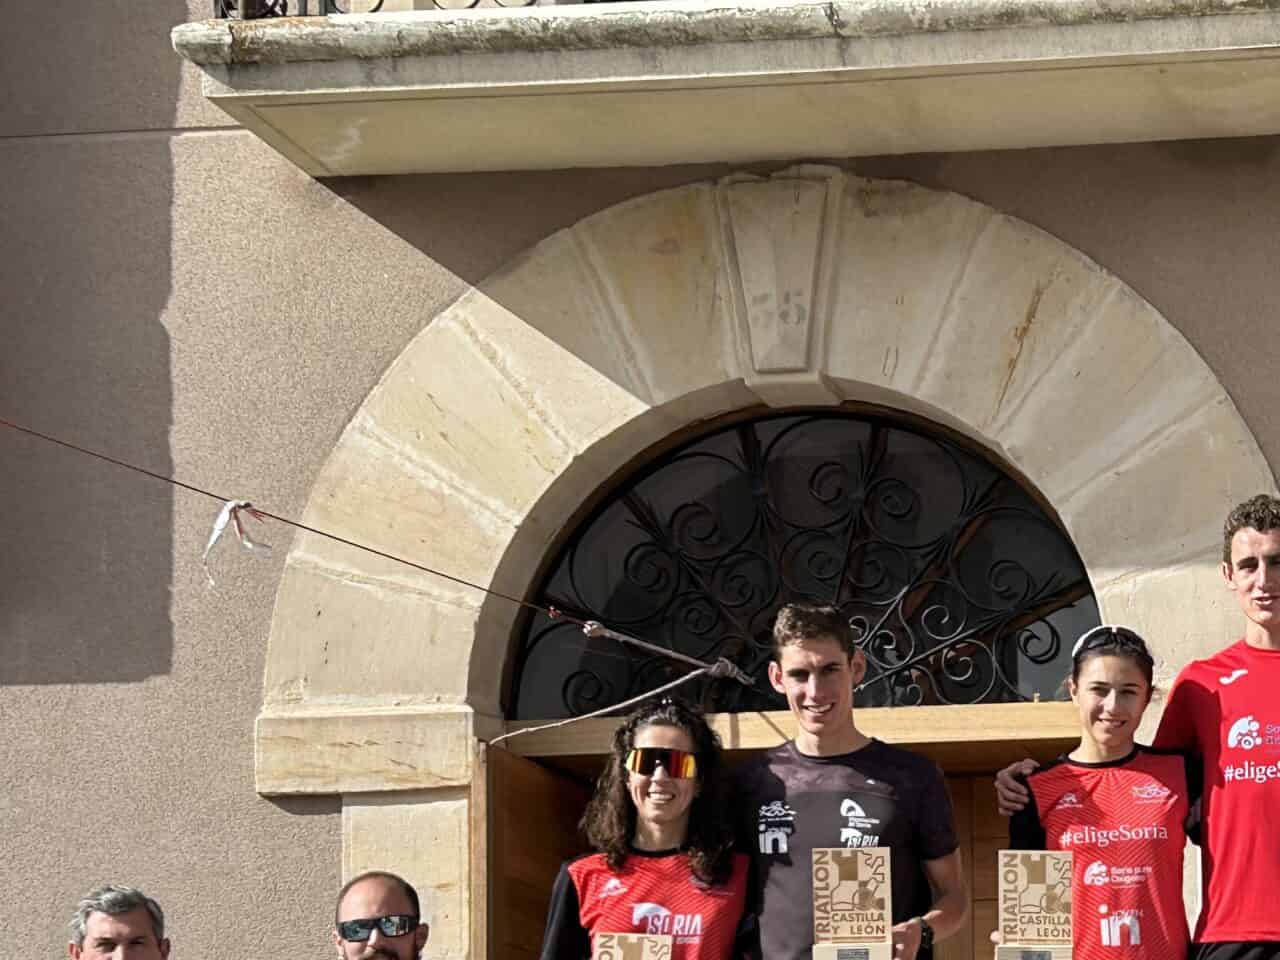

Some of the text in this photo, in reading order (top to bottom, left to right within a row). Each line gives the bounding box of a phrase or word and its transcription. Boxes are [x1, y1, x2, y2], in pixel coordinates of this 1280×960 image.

[1060, 824, 1168, 848] #eligeSoria
[815, 850, 830, 942] TRIATLON
[1003, 853, 1018, 944] TRIATLON
[831, 912, 885, 922] CASTILLA
[1019, 915, 1071, 926] CASTILLA
[832, 925, 840, 934] Y
[1020, 927, 1026, 937] Y
